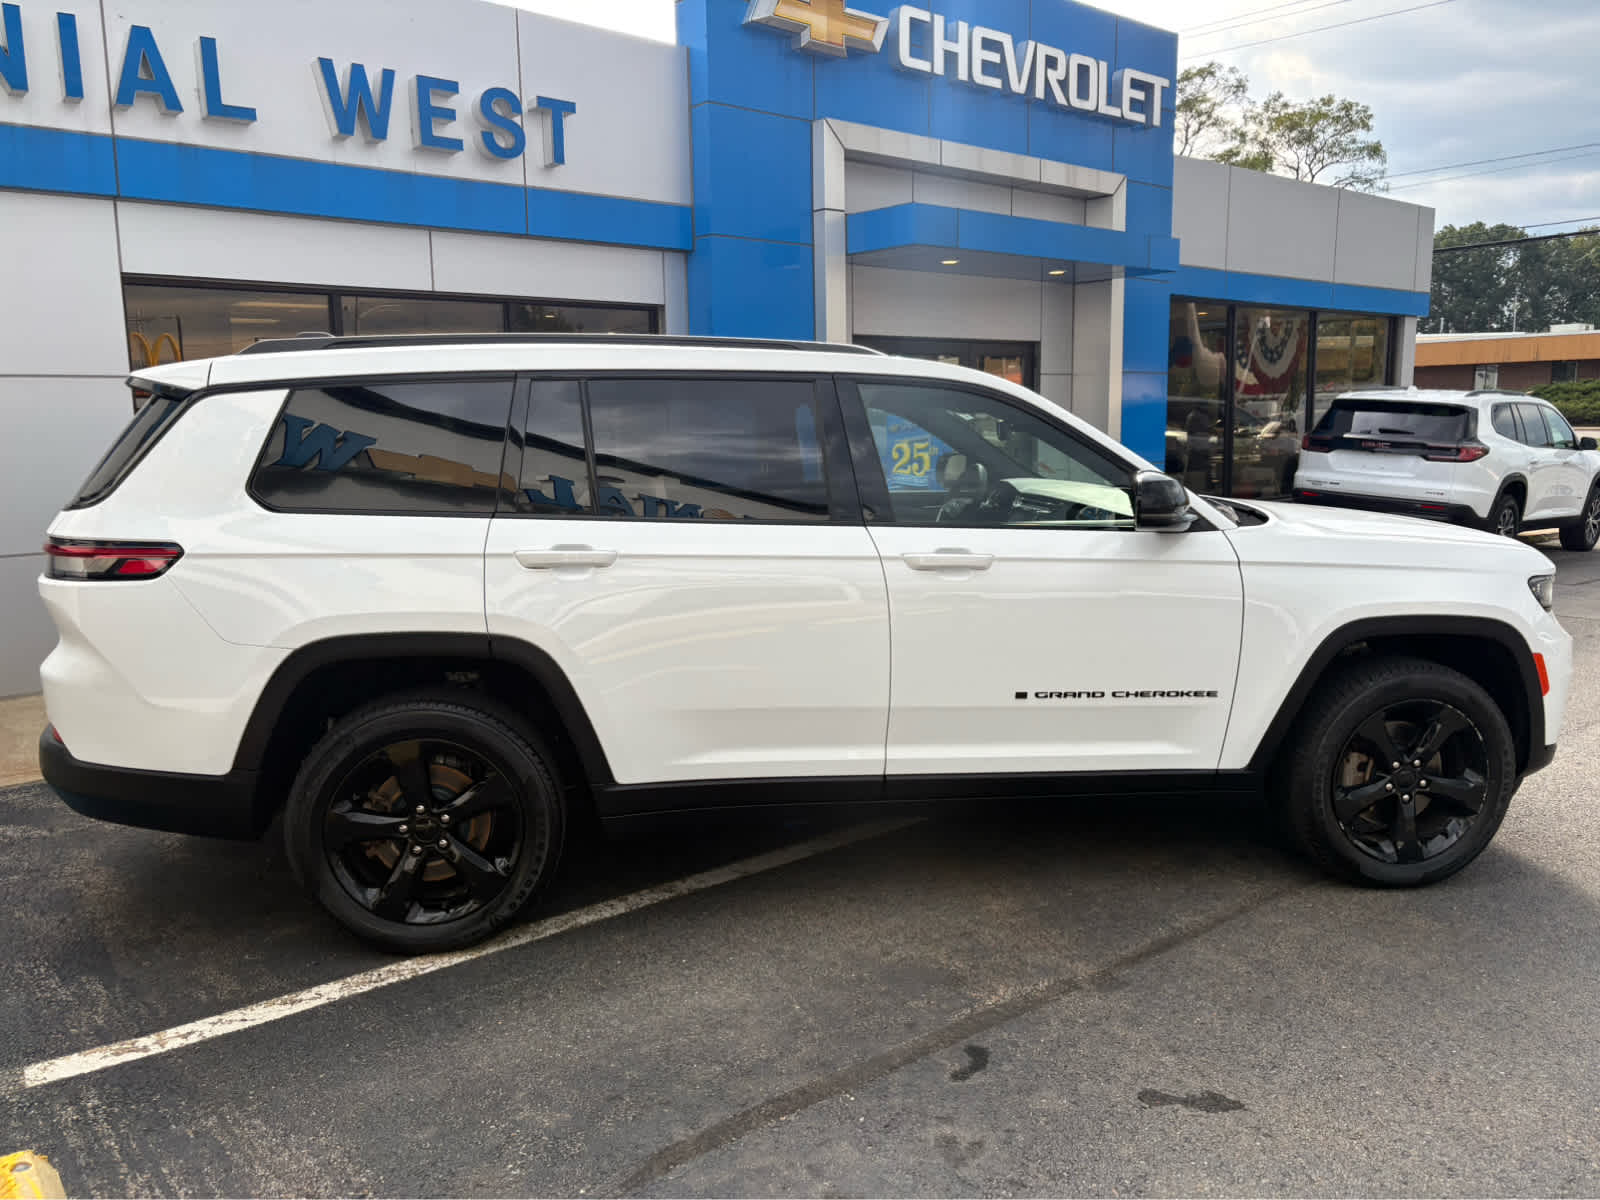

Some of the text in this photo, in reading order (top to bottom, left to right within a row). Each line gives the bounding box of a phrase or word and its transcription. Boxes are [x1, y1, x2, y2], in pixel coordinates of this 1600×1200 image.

[314, 56, 577, 169] WEST
[895, 5, 1170, 128] CHEVROLET
[1034, 690, 1219, 699] GRAND CHEROKEE
